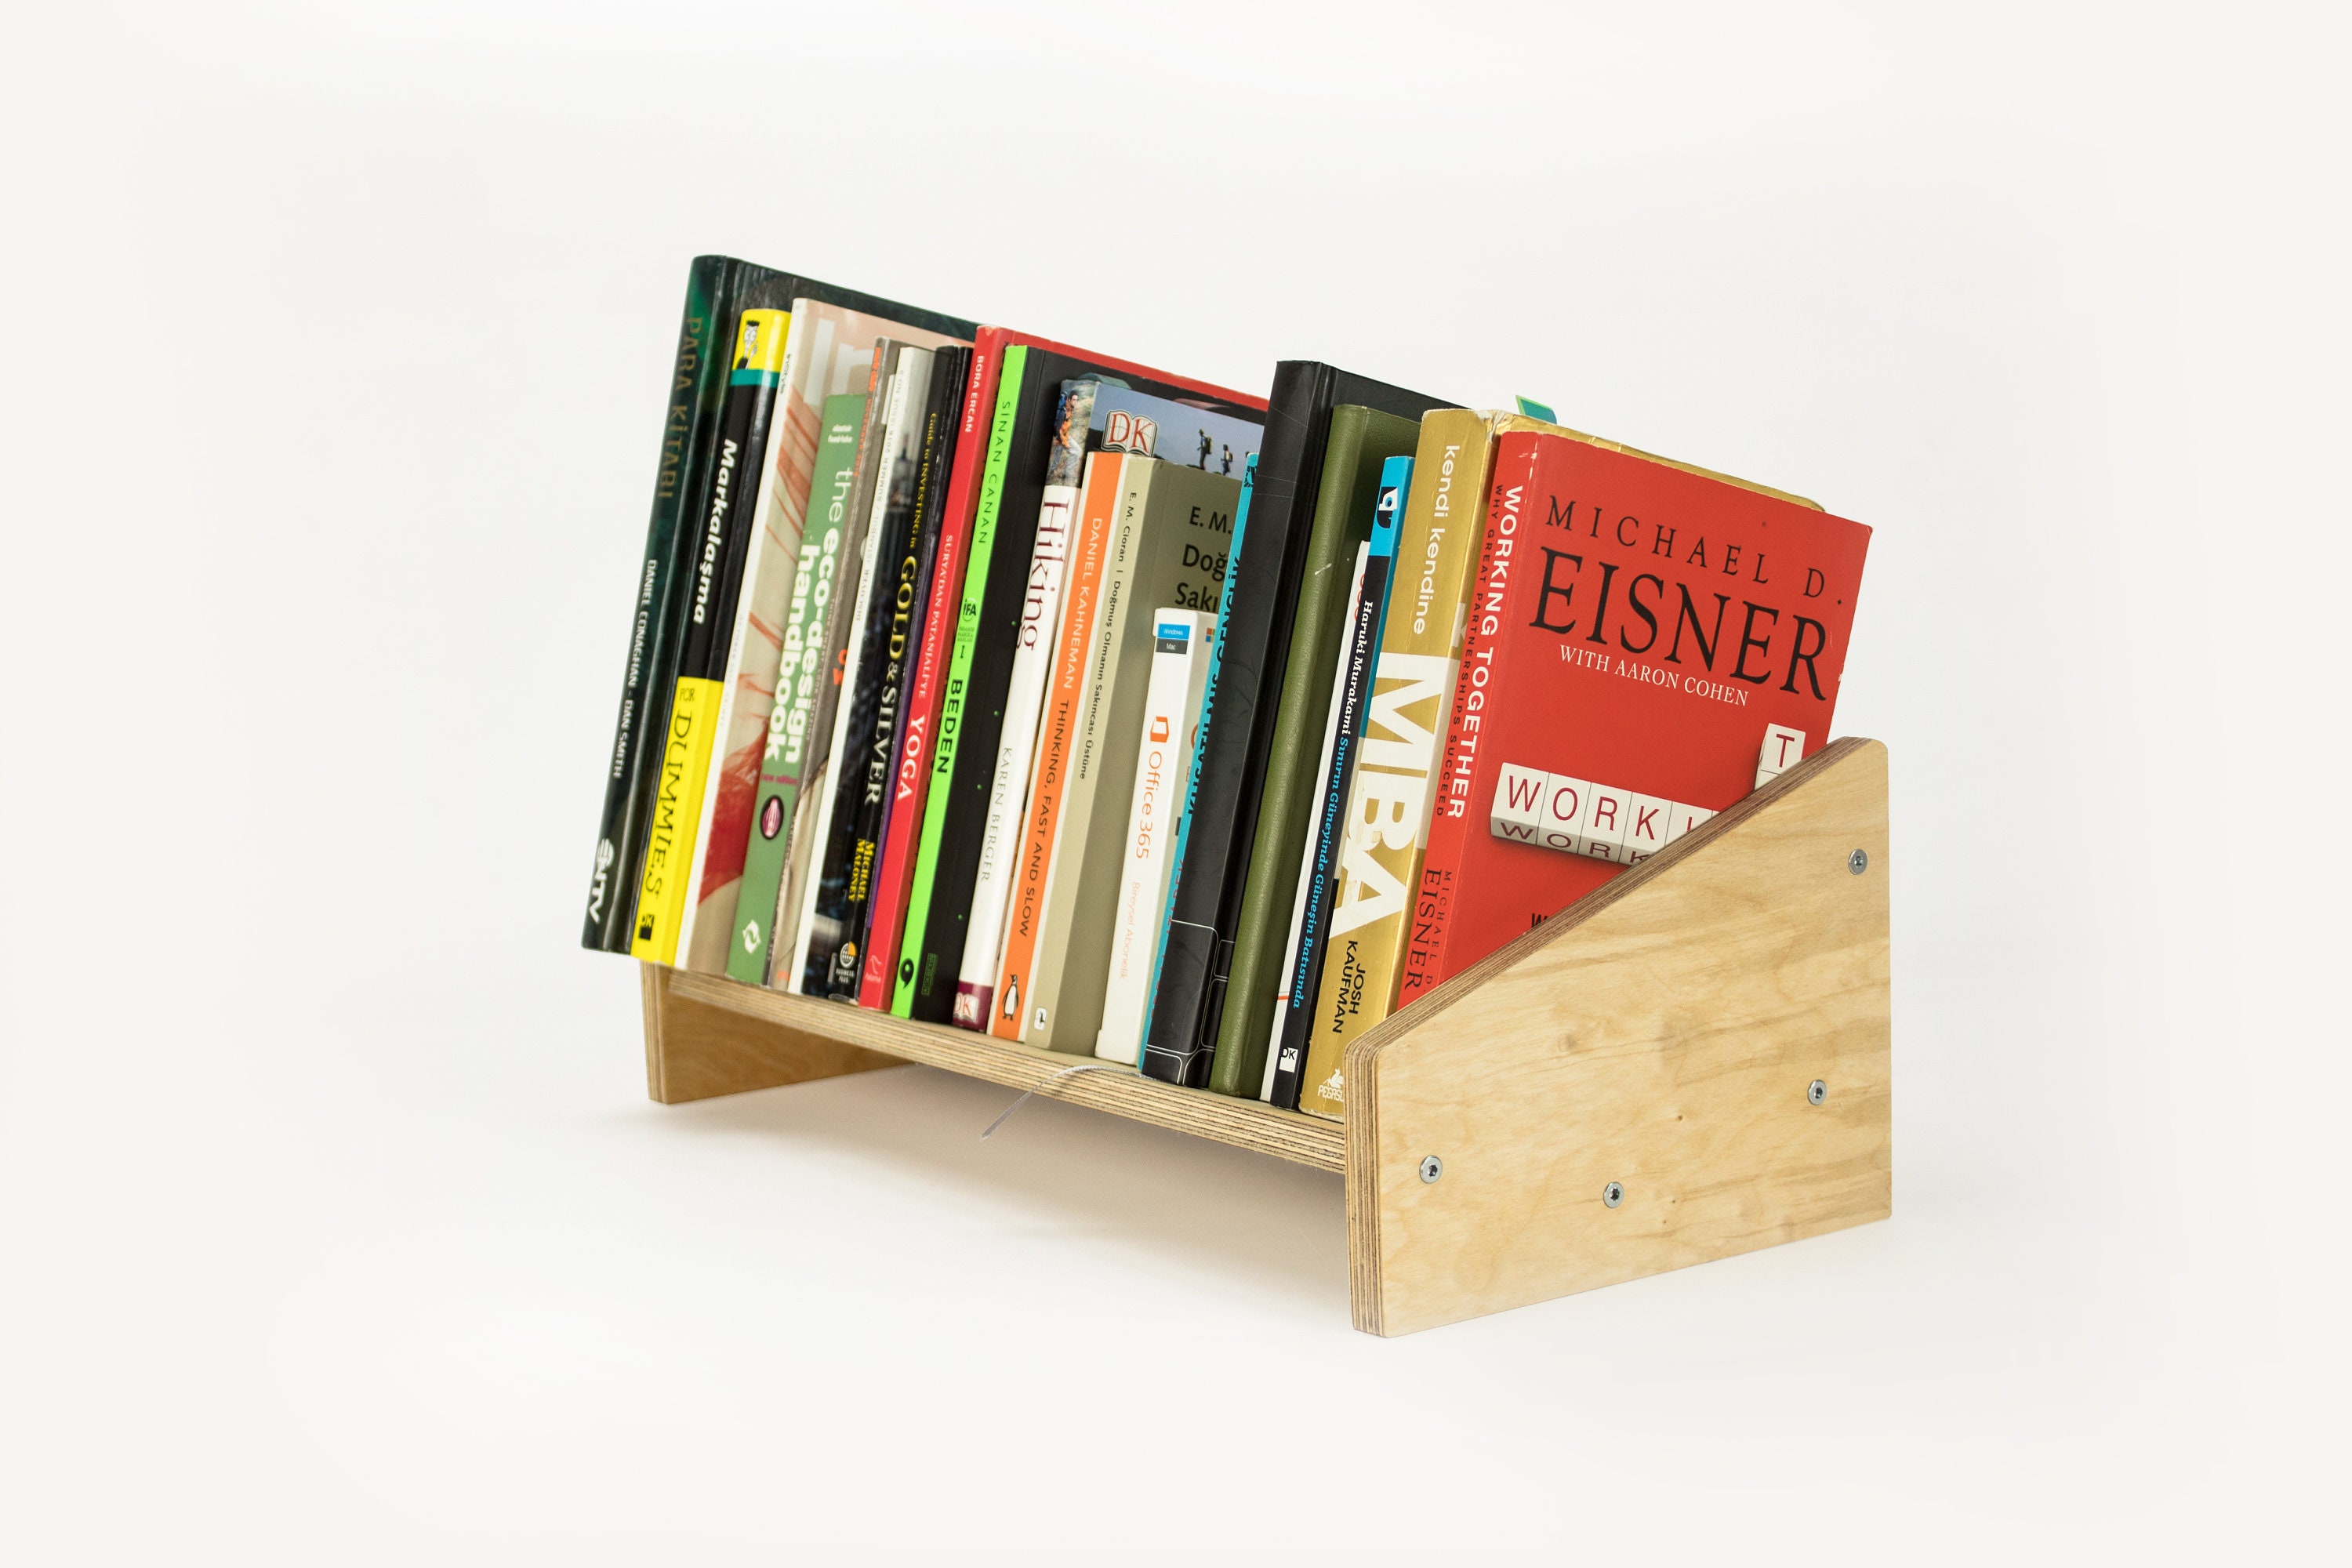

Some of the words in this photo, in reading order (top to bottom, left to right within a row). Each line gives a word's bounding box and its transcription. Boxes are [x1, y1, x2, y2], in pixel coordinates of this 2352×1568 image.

[675, 317, 703, 390] PARA
[971, 355, 985, 390] BORA
[926, 412, 938, 445] Guide
[964, 392, 979, 433] ERCAN
[1106, 412, 1152, 454] DK
[658, 405, 688, 499] KİTABI
[924, 448, 931, 460] to
[1433, 445, 1460, 518] kendi
[829, 466, 854, 524] the
[912, 463, 930, 535] INVESTING
[978, 474, 998, 544] CANAN
[1189, 506, 1204, 528] E.
[1208, 511, 1232, 535] M.
[1490, 484, 1503, 518] WHY
[694, 439, 738, 625] Markalaşma
[855, 568, 869, 622] DISCOVER
[877, 457, 889, 503] SUMMER
[909, 536, 916, 549] in
[1082, 517, 1102, 581] DANIEL
[1119, 526, 1131, 562] Cioran
[1479, 529, 1495, 583] GREAT
[1480, 485, 1523, 637] WORKING
[1545, 495, 1769, 584] MICHAEL
[1802, 567, 1843, 606] D.
[641, 559, 658, 606] DANIEL
[1016, 497, 1070, 652] Hiking
[1108, 581, 1121, 627] Doğmuş
[1412, 527, 1446, 636] kendine
[889, 556, 917, 659] GOLD
[1063, 587, 1089, 689] KAHNEMAN
[1163, 627, 1183, 636] Windows
[1356, 600, 1374, 654] Haruki
[1529, 546, 1828, 702] EISNER
[628, 611, 648, 688] CONAGHAN
[762, 544, 821, 761] handbook
[784, 528, 840, 764] eco-design
[886, 661, 899, 683] &
[1096, 631, 1112, 681] Olmanın
[1166, 642, 1176, 651] Mac
[1453, 593, 1484, 725] PARTNERSHIPS
[1559, 644, 1610, 673] WITH
[1614, 659, 1679, 690] AARON
[1684, 677, 1749, 707] COHEN
[621, 699, 634, 730] DAN
[679, 686, 695, 703] FOR
[936, 678, 964, 774] BEDEN
[1087, 683, 1102, 736] Sakıncası
[1341, 656, 1364, 735] Murakami
[613, 731, 628, 779] SMITH
[865, 685, 896, 805] SILVER
[897, 714, 927, 801] YOGA
[1039, 699, 1069, 790] THINKING,
[1080, 739, 1094, 780] Üstüne
[1447, 646, 1493, 819] TOGETHER
[1776, 734, 1795, 768] T
[994, 747, 1011, 806] KAREN
[1139, 750, 1163, 816] Office
[1328, 737, 1348, 792] Sınırın
[1329, 652, 1457, 939] MBA
[1436, 735, 1457, 816] SUCCEED
[644, 710, 692, 900] DUMMIES
[1035, 795, 1052, 838] FAST
[1317, 793, 1339, 873] Güneyinde
[848, 838, 866, 902] MALONEY
[857, 841, 875, 901] MICHAEL
[979, 814, 1001, 882] BERGER
[1028, 842, 1043, 882] AND
[1135, 821, 1153, 860] 365
[1019, 887, 1036, 938] SLOW
[1127, 881, 1141, 926] Bireysel
[1305, 874, 1325, 933] Güneşin
[1404, 868, 1443, 991] EISNER
[1429, 871, 1452, 961] MICHAEL
[1120, 927, 1134, 979] Abonelik
[1293, 934, 1313, 1009] Batısında
[1332, 940, 1359, 1034] KAUFMAN
[1348, 964, 1366, 1014] JOSH
